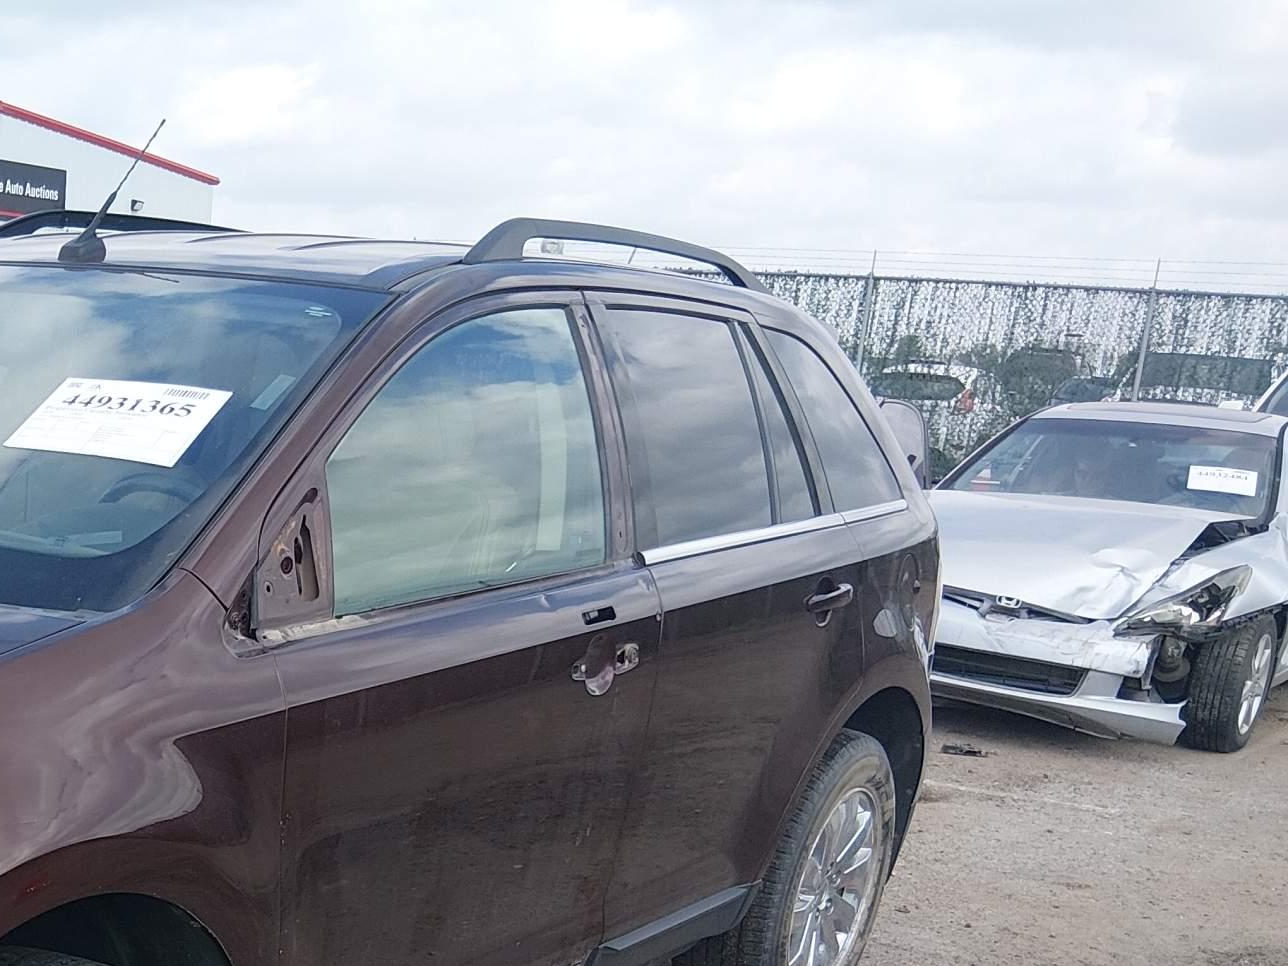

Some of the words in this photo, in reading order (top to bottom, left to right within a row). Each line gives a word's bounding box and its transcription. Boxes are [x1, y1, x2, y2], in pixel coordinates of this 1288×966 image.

[5, 178, 24, 196] Auto
[24, 182, 59, 201] Auctions
[63, 393, 197, 417] 44931365
